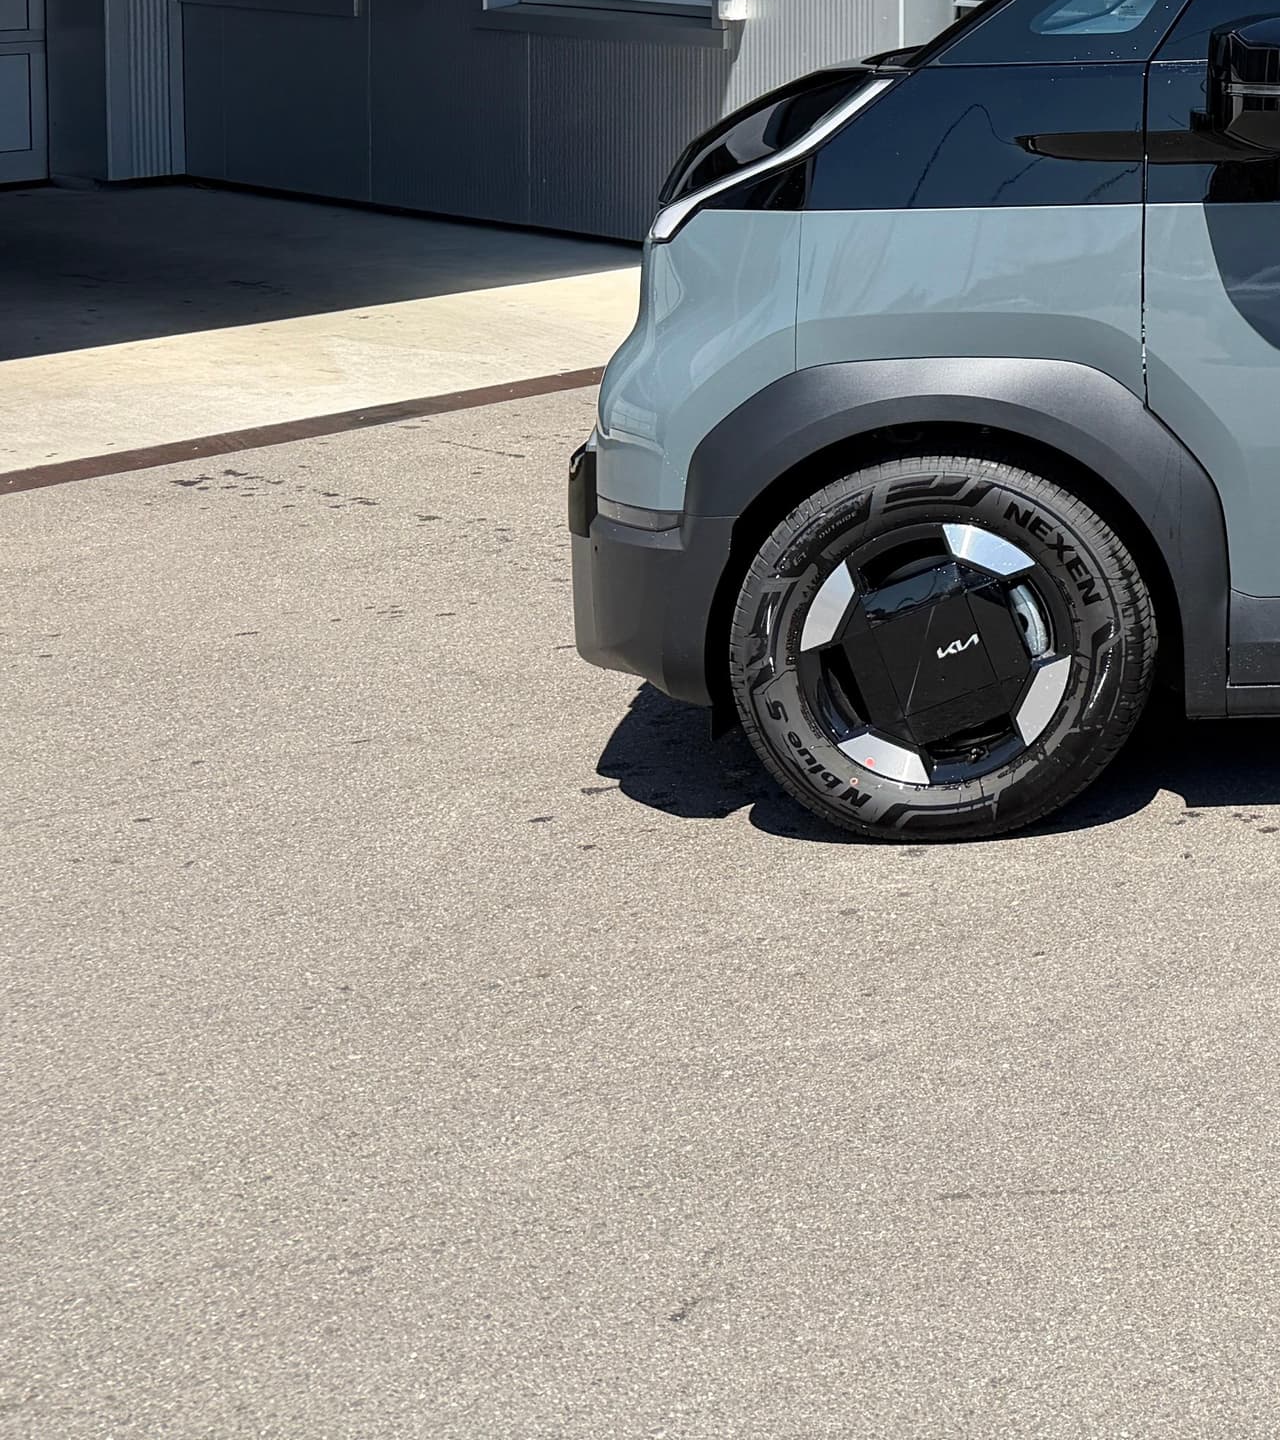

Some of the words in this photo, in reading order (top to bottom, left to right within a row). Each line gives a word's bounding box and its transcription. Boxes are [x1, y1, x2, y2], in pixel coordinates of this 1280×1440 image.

[1003, 501, 1102, 606] NEXEN
[937, 633, 979, 659] KIA
[788, 731, 843, 789] blue
